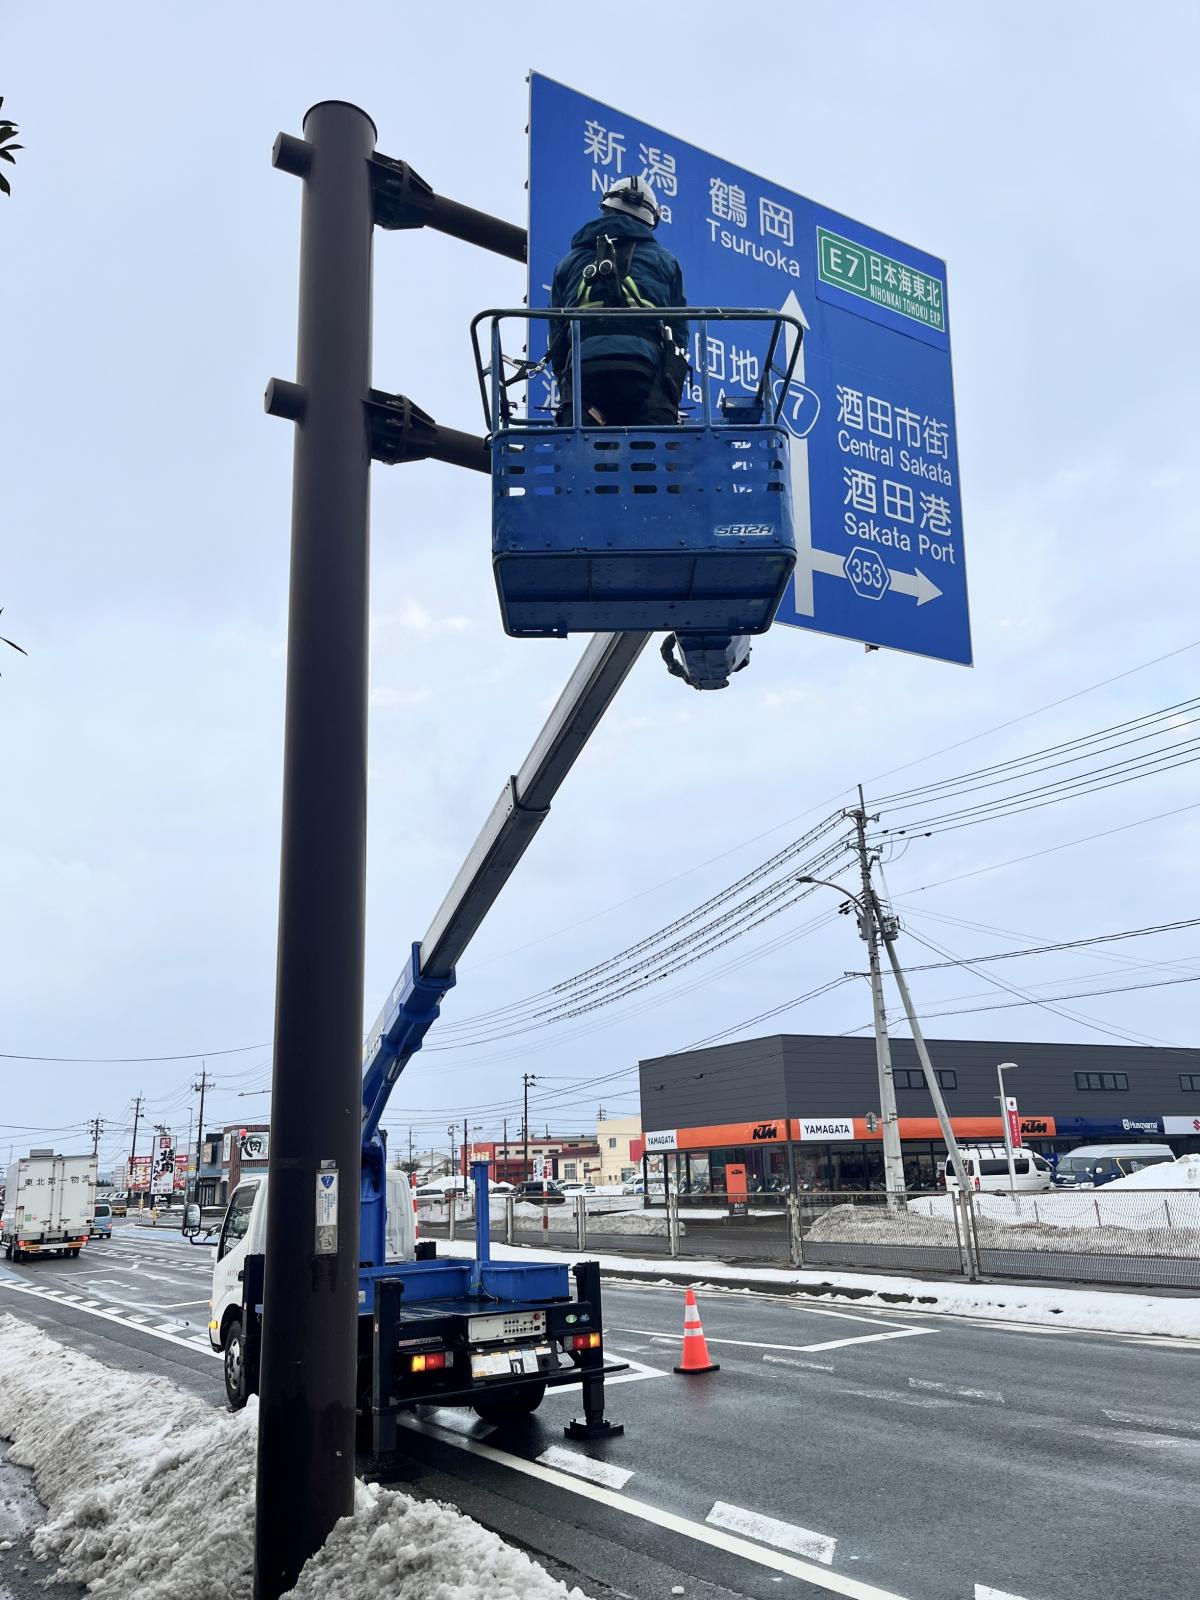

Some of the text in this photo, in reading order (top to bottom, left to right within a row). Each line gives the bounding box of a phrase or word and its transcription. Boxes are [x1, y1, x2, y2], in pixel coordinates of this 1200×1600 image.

[584, 120, 678, 197] 新潟
[709, 177, 794, 247] 鶴岡
[706, 217, 800, 278] Tsuruoka
[830, 247, 859, 278] E7
[870, 255, 940, 308] 日本海東北
[870, 283, 901, 309] NIHONKAI
[903, 297, 928, 321] TOHOKU
[787, 391, 804, 421] 7
[836, 384, 949, 460] 酒田市街
[837, 429, 953, 487] Central Sakata
[843, 466, 952, 538] 酒田港
[843, 512, 956, 565] Sakata Port
[851, 561, 883, 590] 353
[647, 1136, 675, 1146] YAMAGATA
[752, 1124, 778, 1140] KTM
[803, 1124, 850, 1135] YAMAGATA
[1020, 1119, 1048, 1134] KTM
